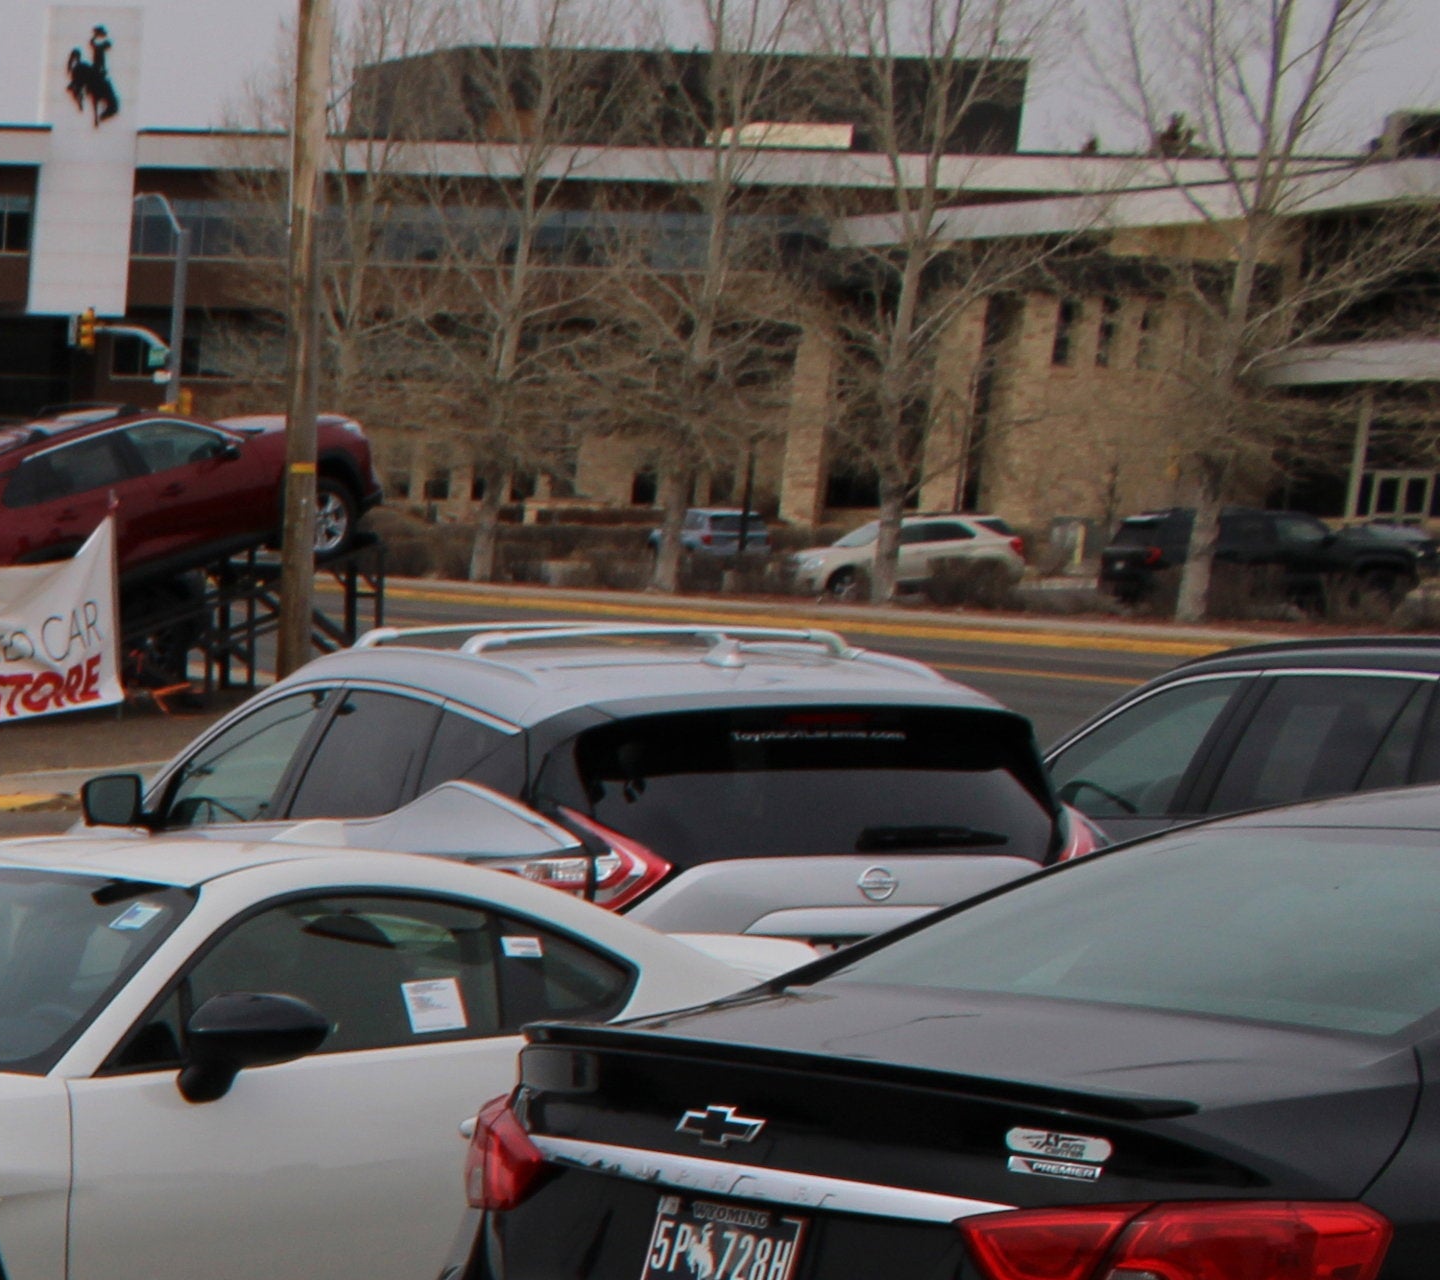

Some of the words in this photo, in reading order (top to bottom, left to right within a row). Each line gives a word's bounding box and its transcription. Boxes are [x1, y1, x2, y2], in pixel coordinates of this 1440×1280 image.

[41, 601, 103, 662] CAR
[1032, 1163, 1095, 1178] PREMIER
[692, 1201, 772, 1229] WYOMING
